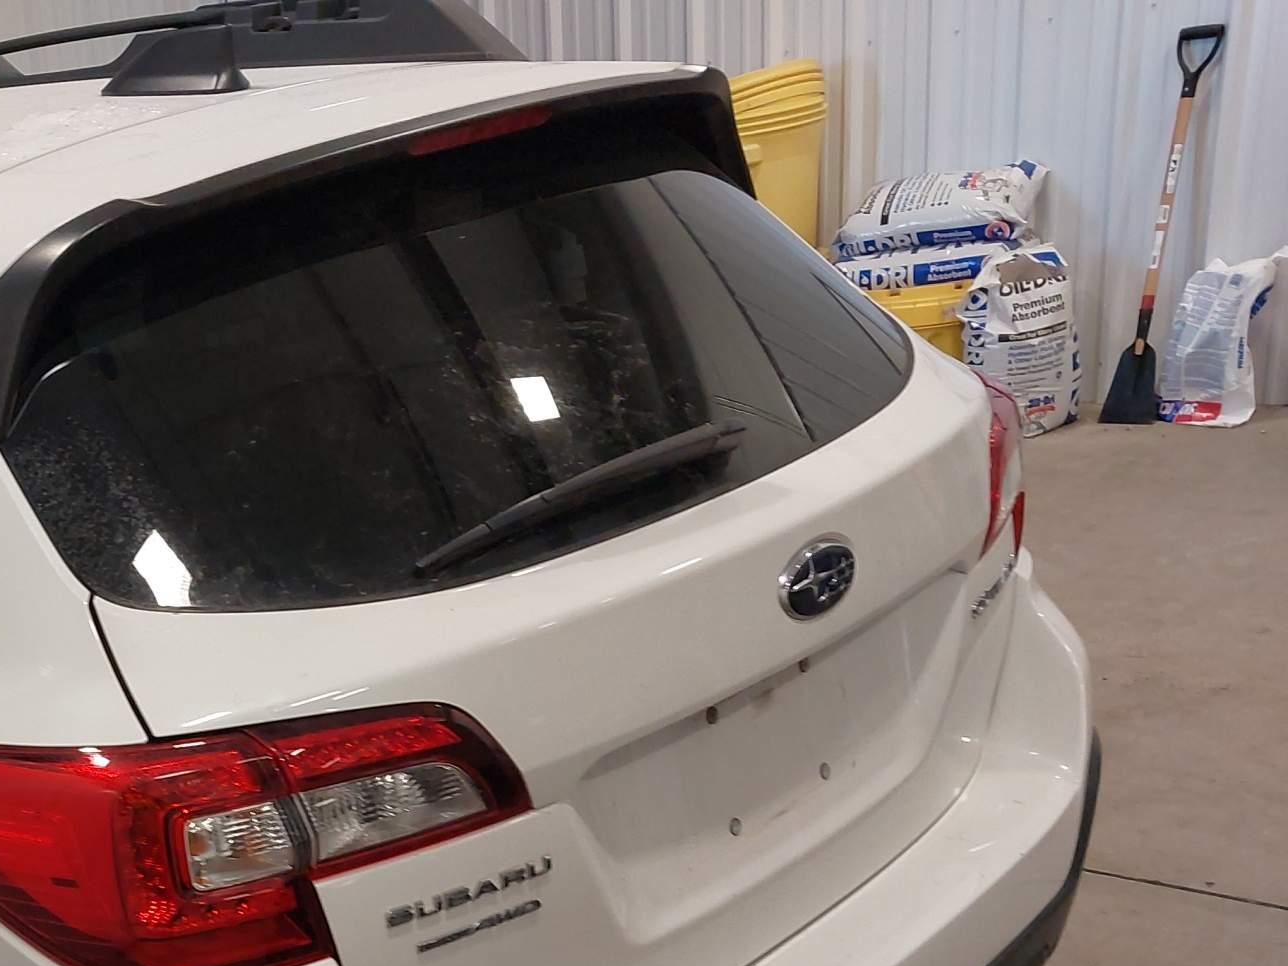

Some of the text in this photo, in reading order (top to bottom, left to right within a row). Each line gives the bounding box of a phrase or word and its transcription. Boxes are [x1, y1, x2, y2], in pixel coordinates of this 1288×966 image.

[1011, 301, 1065, 321] Absorbent
[1012, 293, 1064, 312] Premium
[385, 855, 552, 928] SUBARU
